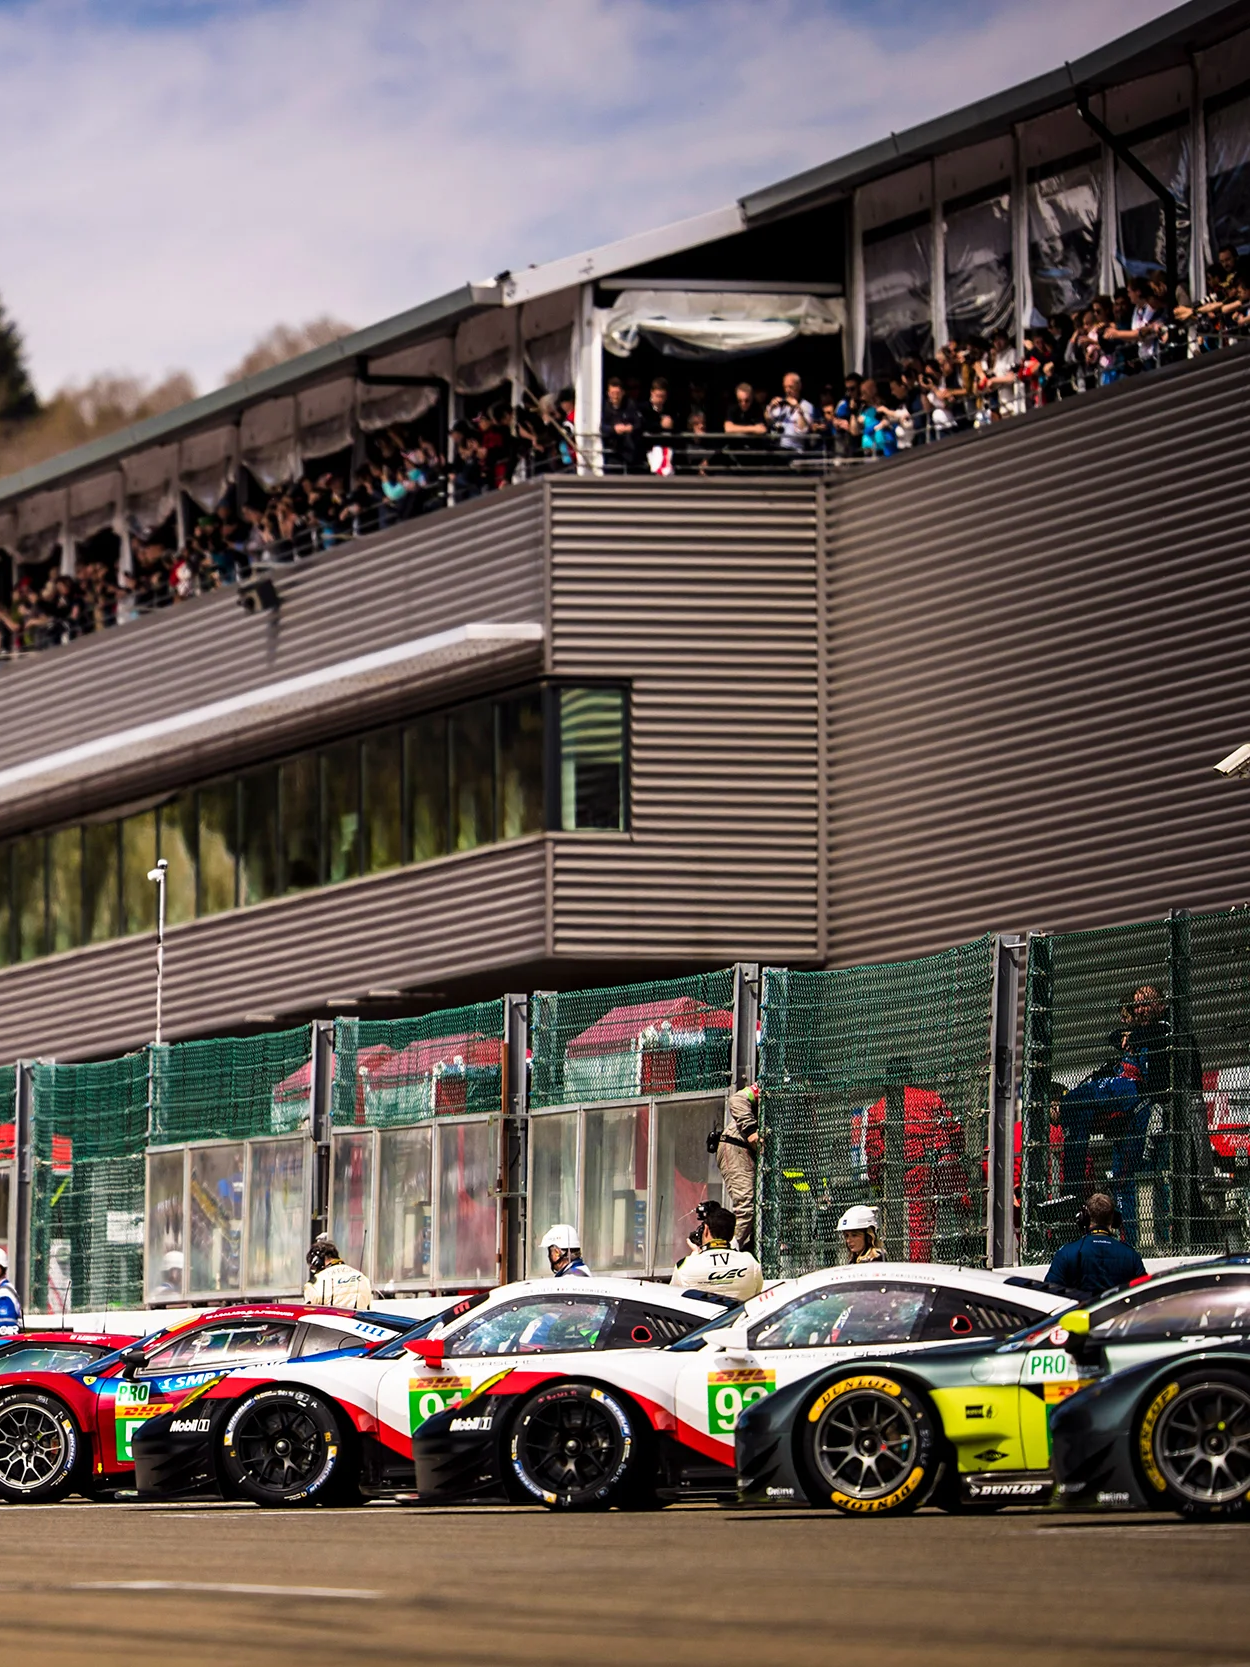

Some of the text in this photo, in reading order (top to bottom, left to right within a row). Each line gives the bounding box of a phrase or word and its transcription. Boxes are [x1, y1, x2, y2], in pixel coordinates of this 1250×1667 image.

[710, 1253, 730, 1266] TV
[708, 1268, 747, 1281] WEC
[1030, 1354, 1067, 1376] PRO
[174, 1372, 216, 1389] SMP
[416, 1377, 463, 1388] DHL
[118, 1384, 148, 1402] PRO
[820, 1378, 893, 1404] DUNLOP
[123, 1406, 162, 1416] DHL
[227, 1398, 254, 1433] MICHELIN
[604, 1397, 630, 1436] MICHELIN
[170, 1419, 199, 1432] Mobil
[450, 1418, 480, 1432] Mobil
[68, 1432, 76, 1469] MICHELIN
[840, 1485, 912, 1511] DUNLOP
[980, 1484, 1043, 1496] DUNLOP
